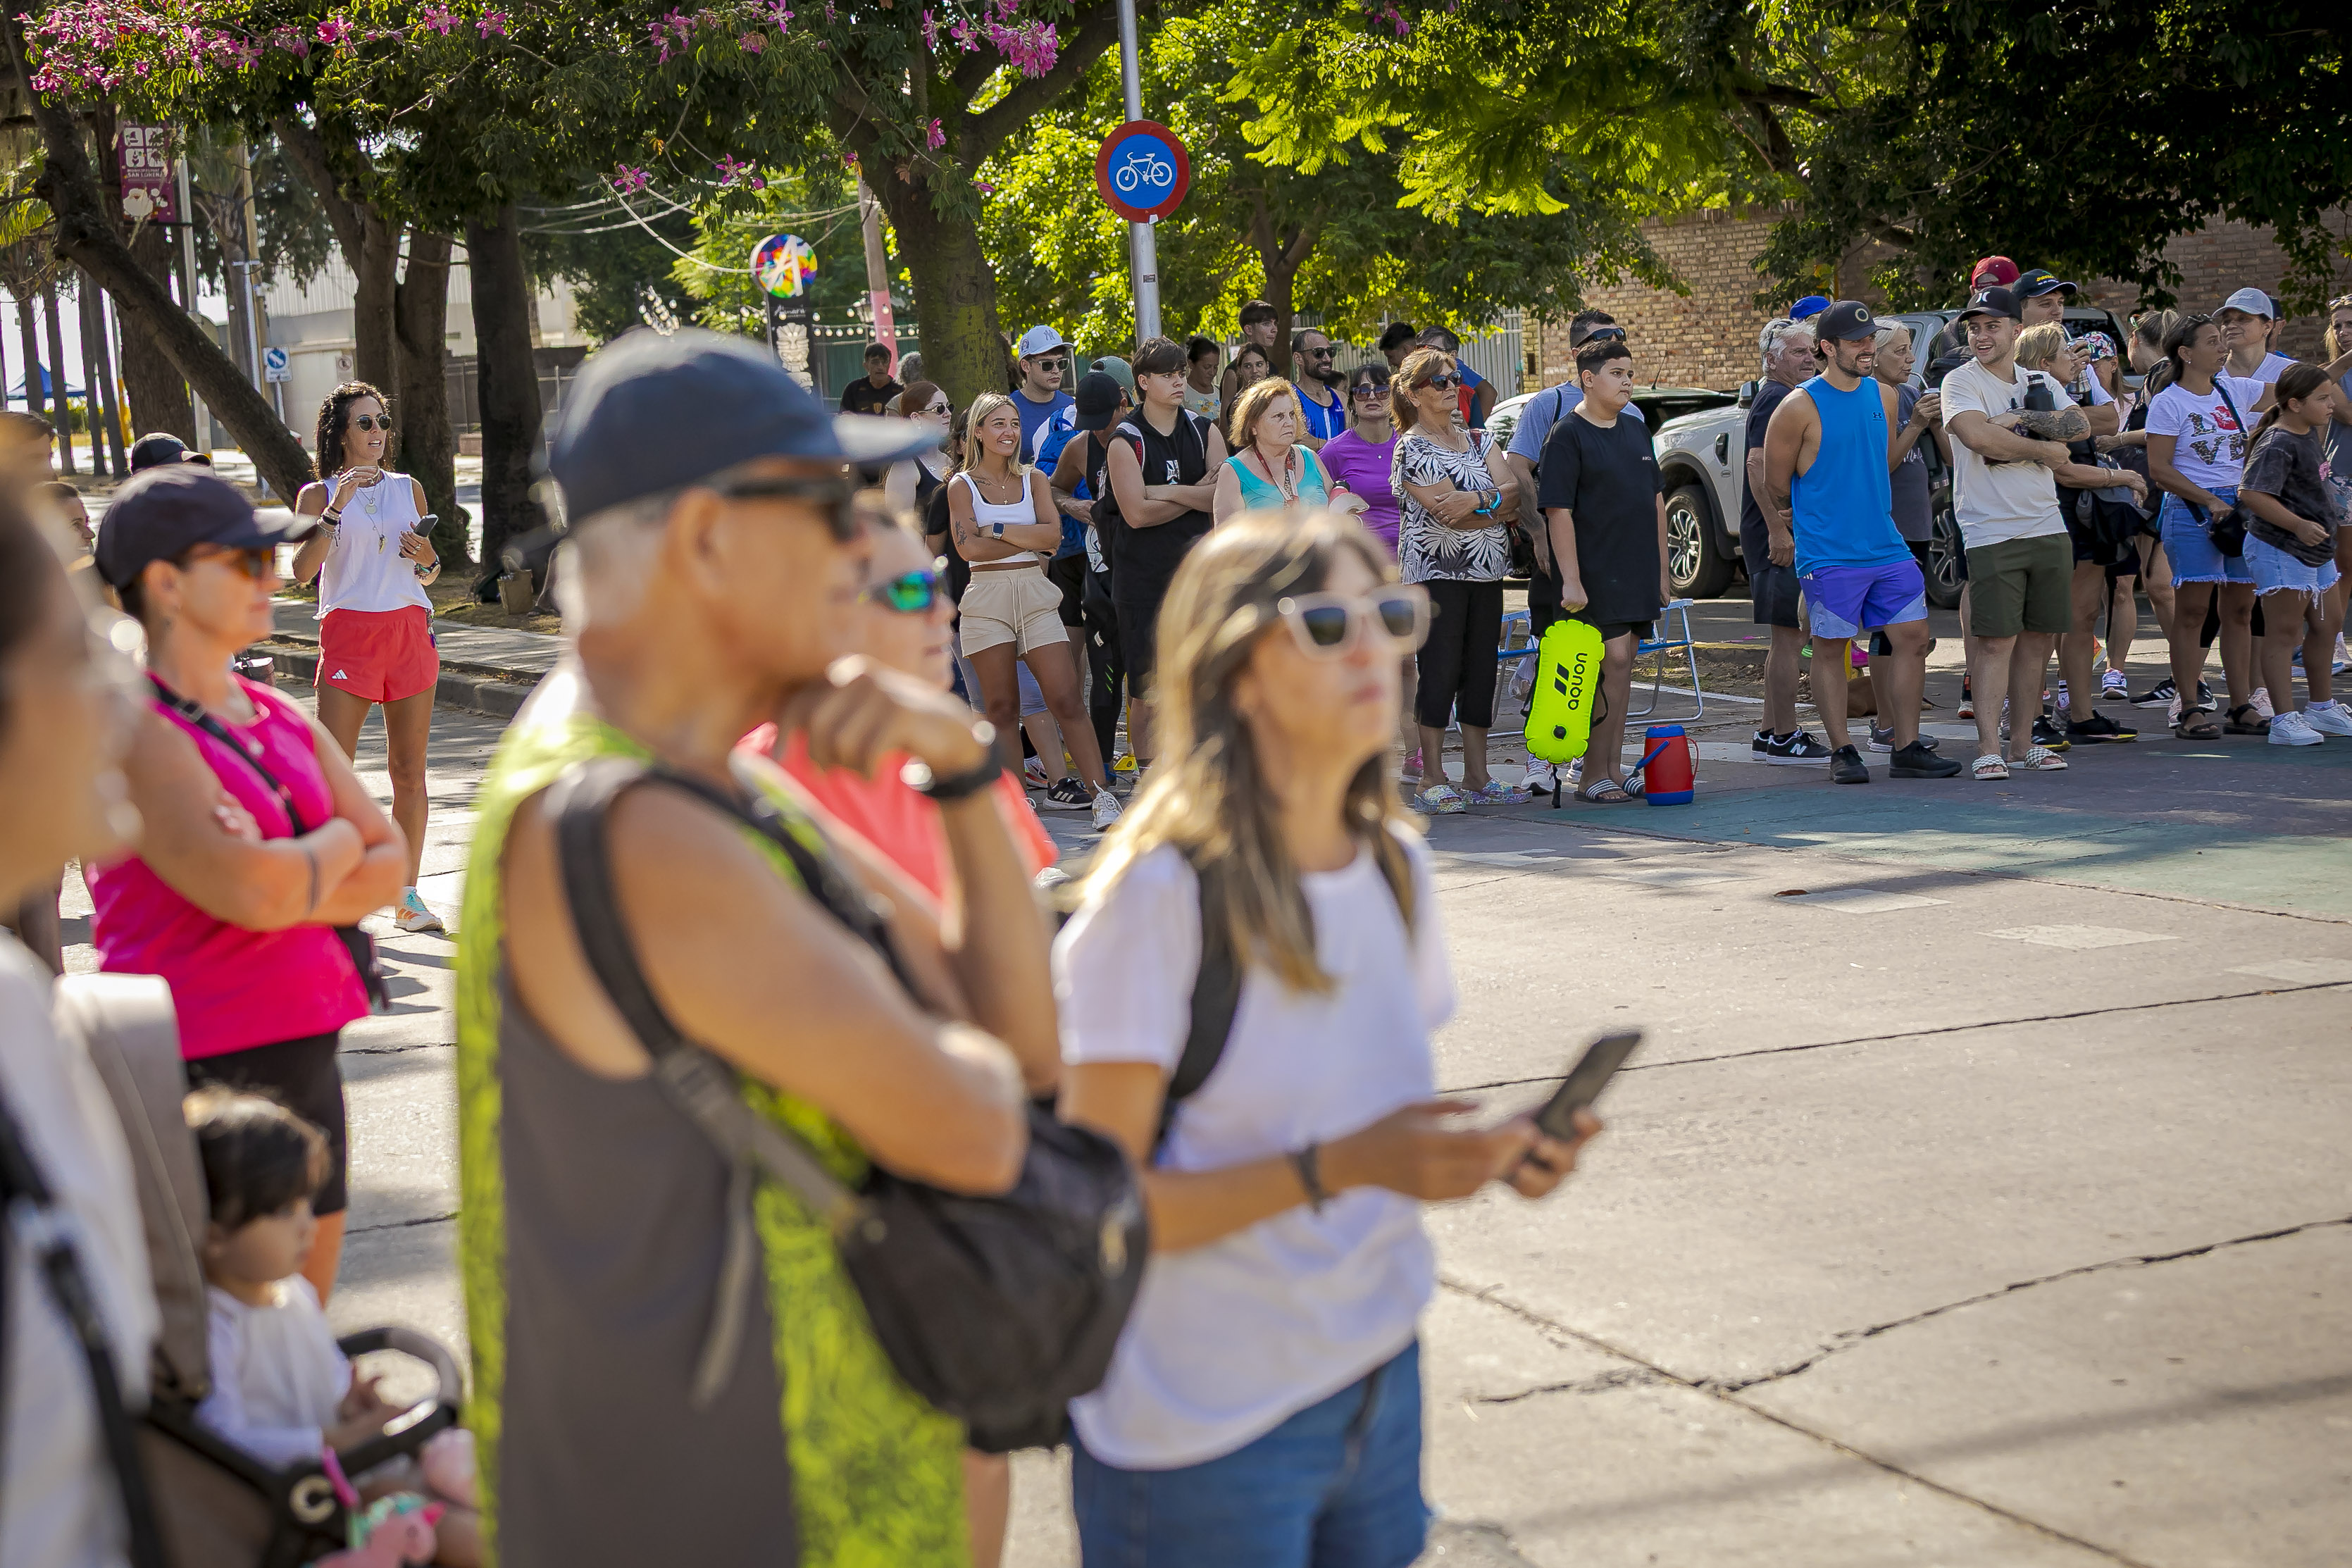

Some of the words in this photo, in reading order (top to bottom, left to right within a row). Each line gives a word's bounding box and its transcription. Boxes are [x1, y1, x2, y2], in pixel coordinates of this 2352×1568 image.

[1043, 329, 1056, 341] NY
[1567, 652, 1588, 711] aquon
[1790, 743, 1807, 755] N
